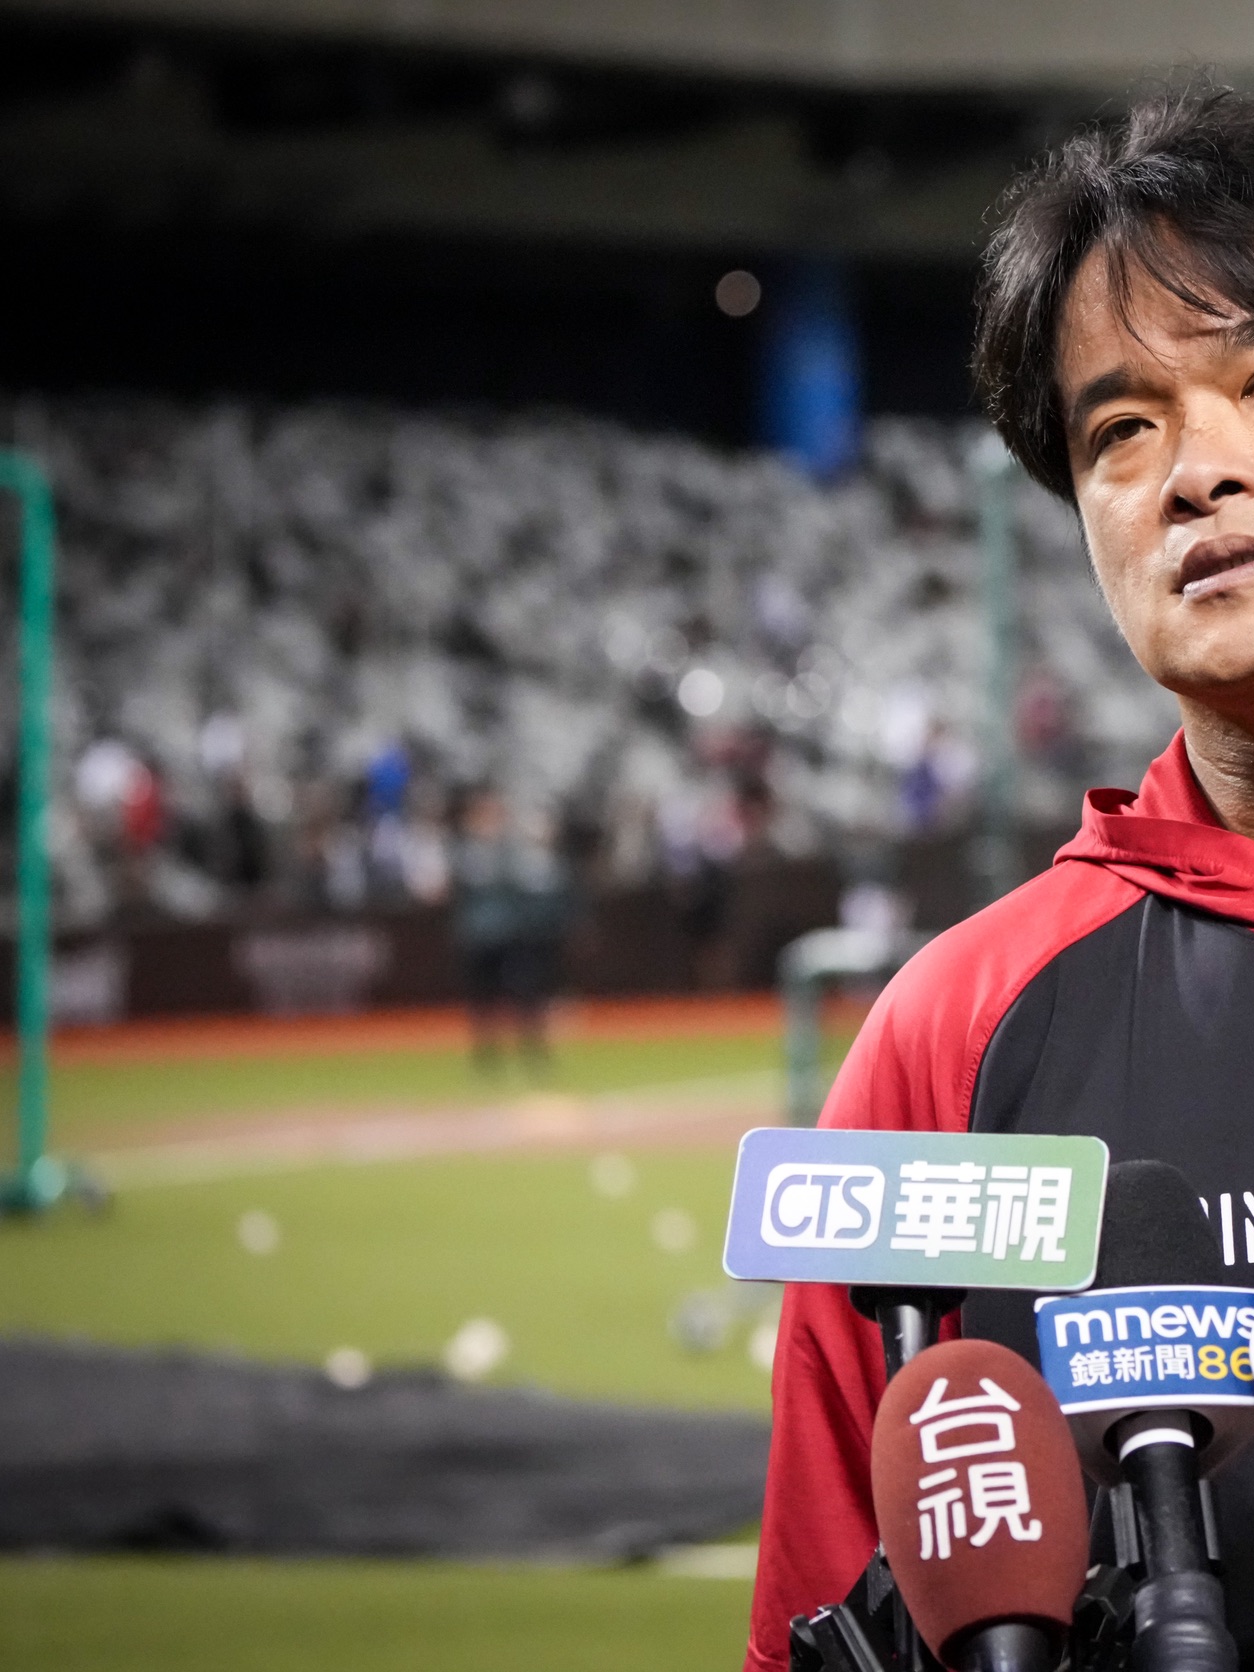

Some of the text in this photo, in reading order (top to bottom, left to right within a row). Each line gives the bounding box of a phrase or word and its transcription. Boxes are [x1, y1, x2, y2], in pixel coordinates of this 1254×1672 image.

[769, 1173, 874, 1240] CTS
[889, 1160, 1073, 1262] 華視
[909, 1377, 1043, 1560] 台視
